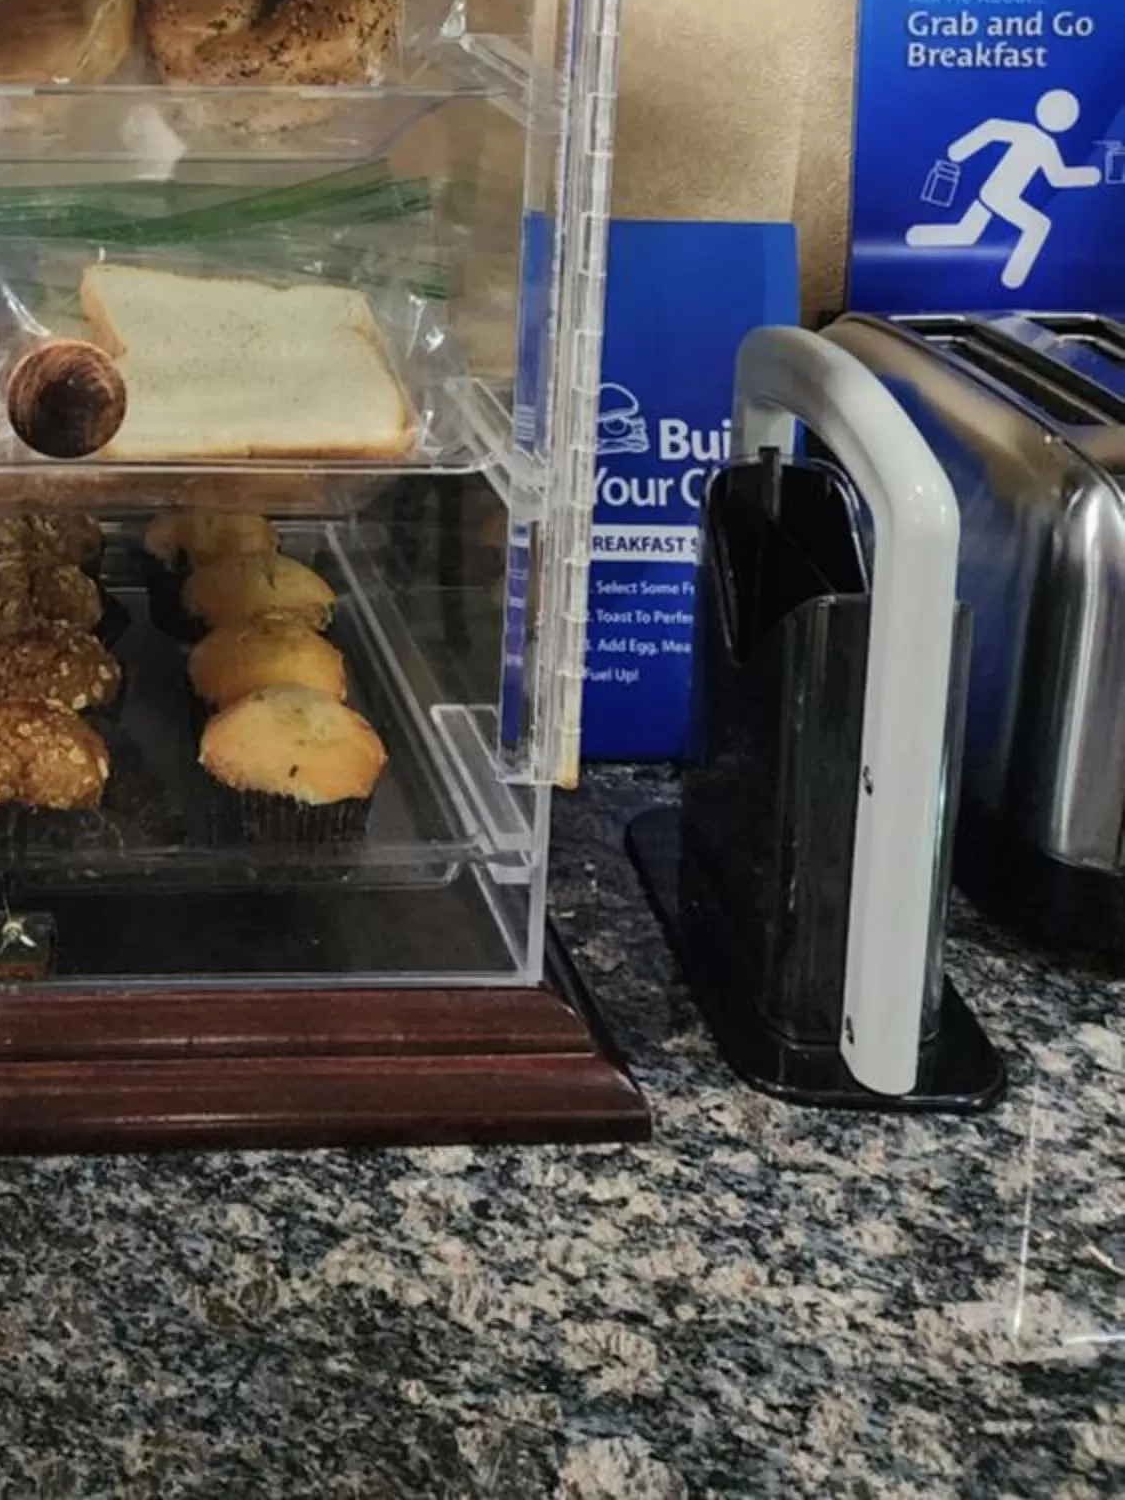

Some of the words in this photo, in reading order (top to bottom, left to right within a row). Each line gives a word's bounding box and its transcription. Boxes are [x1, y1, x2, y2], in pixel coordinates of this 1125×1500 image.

[907, 10, 980, 37] Grab
[986, 10, 1044, 38] and
[1052, 11, 1095, 38] Go
[907, 41, 1049, 68] Breakfast
[596, 580, 637, 595] Select
[640, 581, 680, 595] Some
[595, 609, 632, 624] Toast
[635, 610, 652, 625] To
[597, 637, 626, 652] Add
[629, 638, 660, 656] Egg,
[615, 667, 640, 687] Up!
